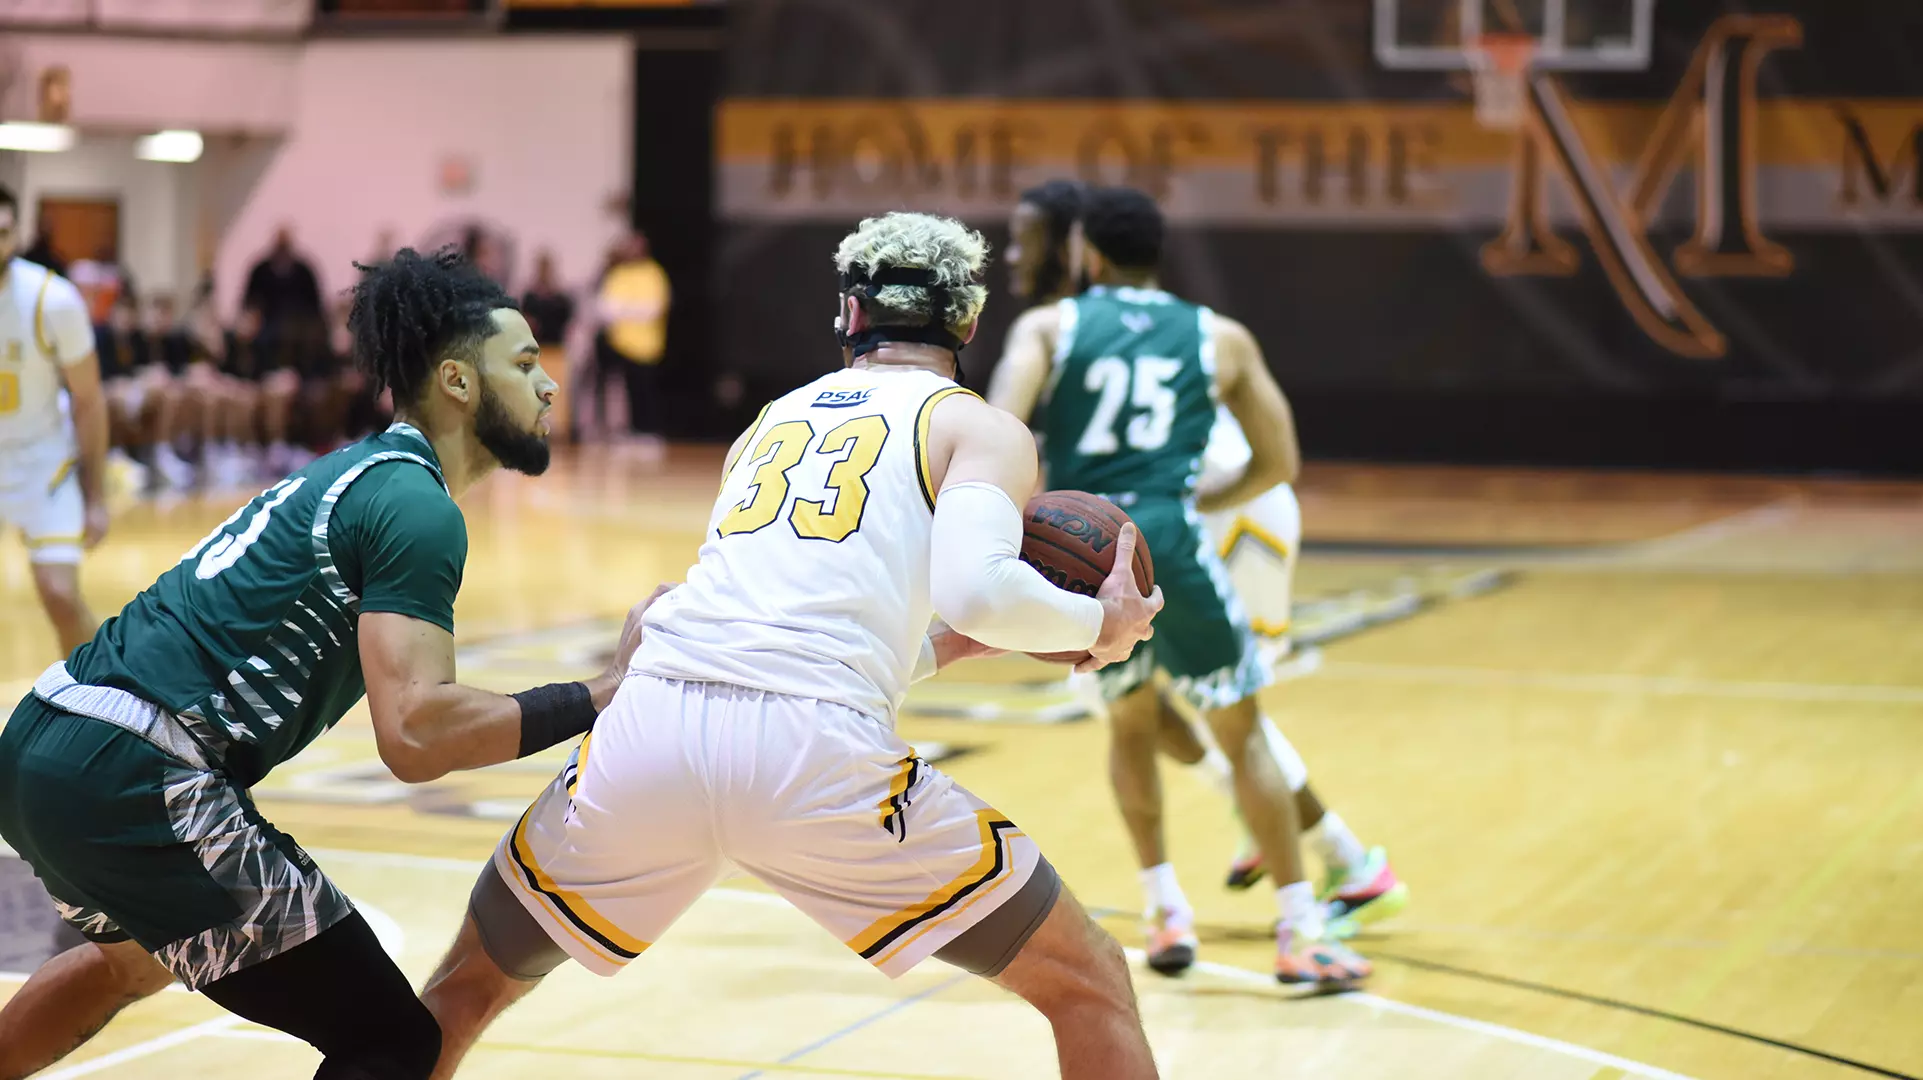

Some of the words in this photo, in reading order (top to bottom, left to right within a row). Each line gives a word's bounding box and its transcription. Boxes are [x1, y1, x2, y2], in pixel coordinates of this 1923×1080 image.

[767, 108, 1040, 204] HOME
[1240, 116, 1450, 208] THE
[1480, 14, 1803, 358] M
[815, 387, 878, 402] PSAC
[1076, 357, 1182, 455] 25
[716, 414, 890, 543] 33
[1031, 505, 1114, 553] NCAA
